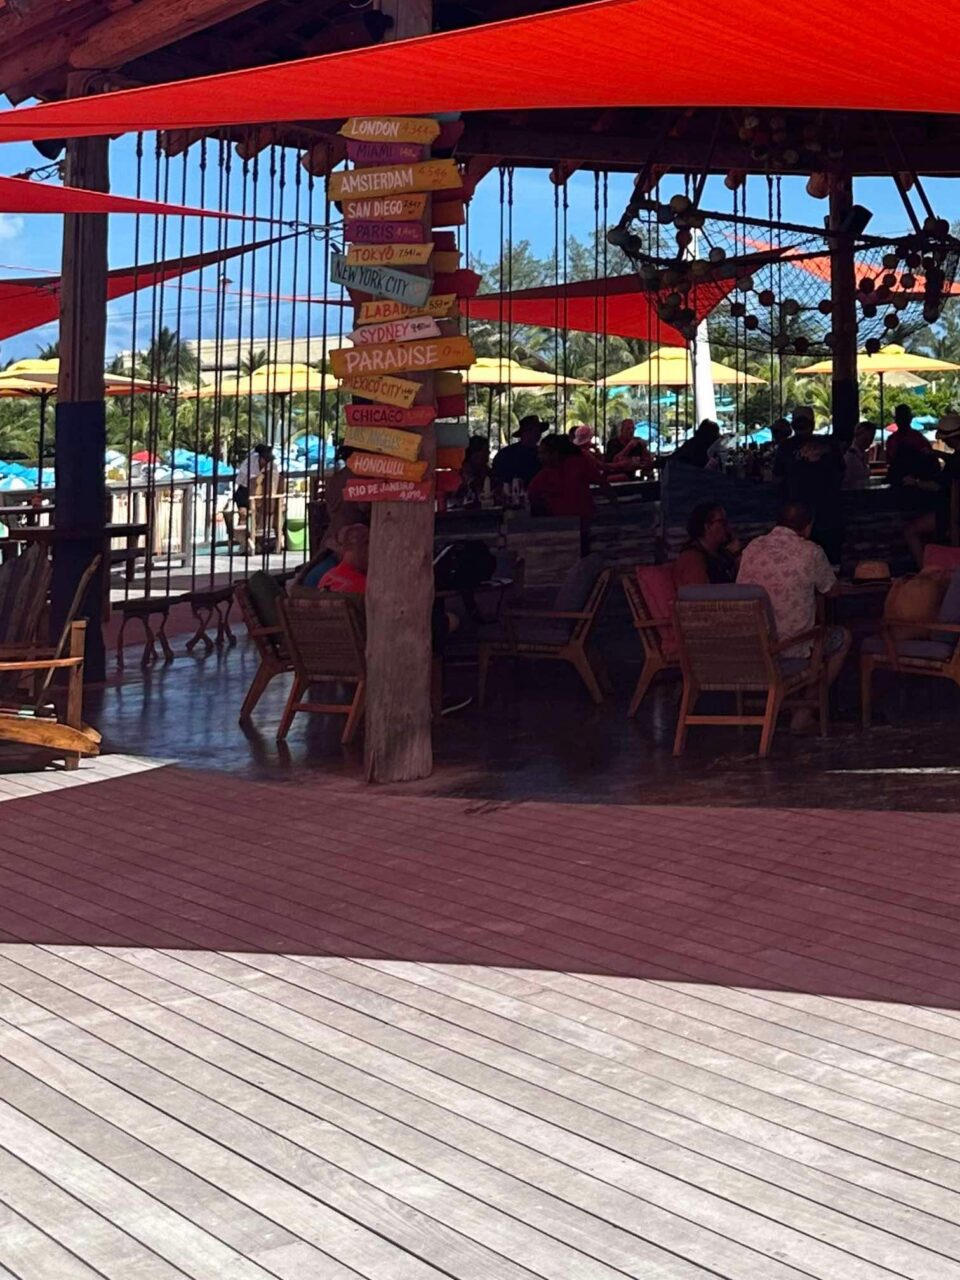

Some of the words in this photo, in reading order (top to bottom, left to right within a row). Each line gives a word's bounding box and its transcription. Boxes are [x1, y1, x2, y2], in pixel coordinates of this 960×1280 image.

[351, 119, 400, 137] LONDON
[356, 143, 392, 158] MIAMI
[341, 168, 414, 192] AMSTERDAM
[347, 202, 372, 218] SAN
[374, 200, 402, 217] DIEGO
[356, 224, 394, 240] PARIS
[351, 247, 394, 262] TOKYO
[335, 262, 355, 283] NEW
[359, 266, 383, 290] YORK
[384, 275, 409, 297] CITY
[360, 322, 409, 344] SYDNEY
[344, 345, 438, 373] PARADISE
[381, 381, 402, 398] CITY
[352, 409, 404, 423] CHICAGO
[353, 455, 404, 475] HONOLULU
[348, 485, 366, 498] RIO
[367, 484, 379, 494] DE
[379, 481, 415, 493] JANEIRO
